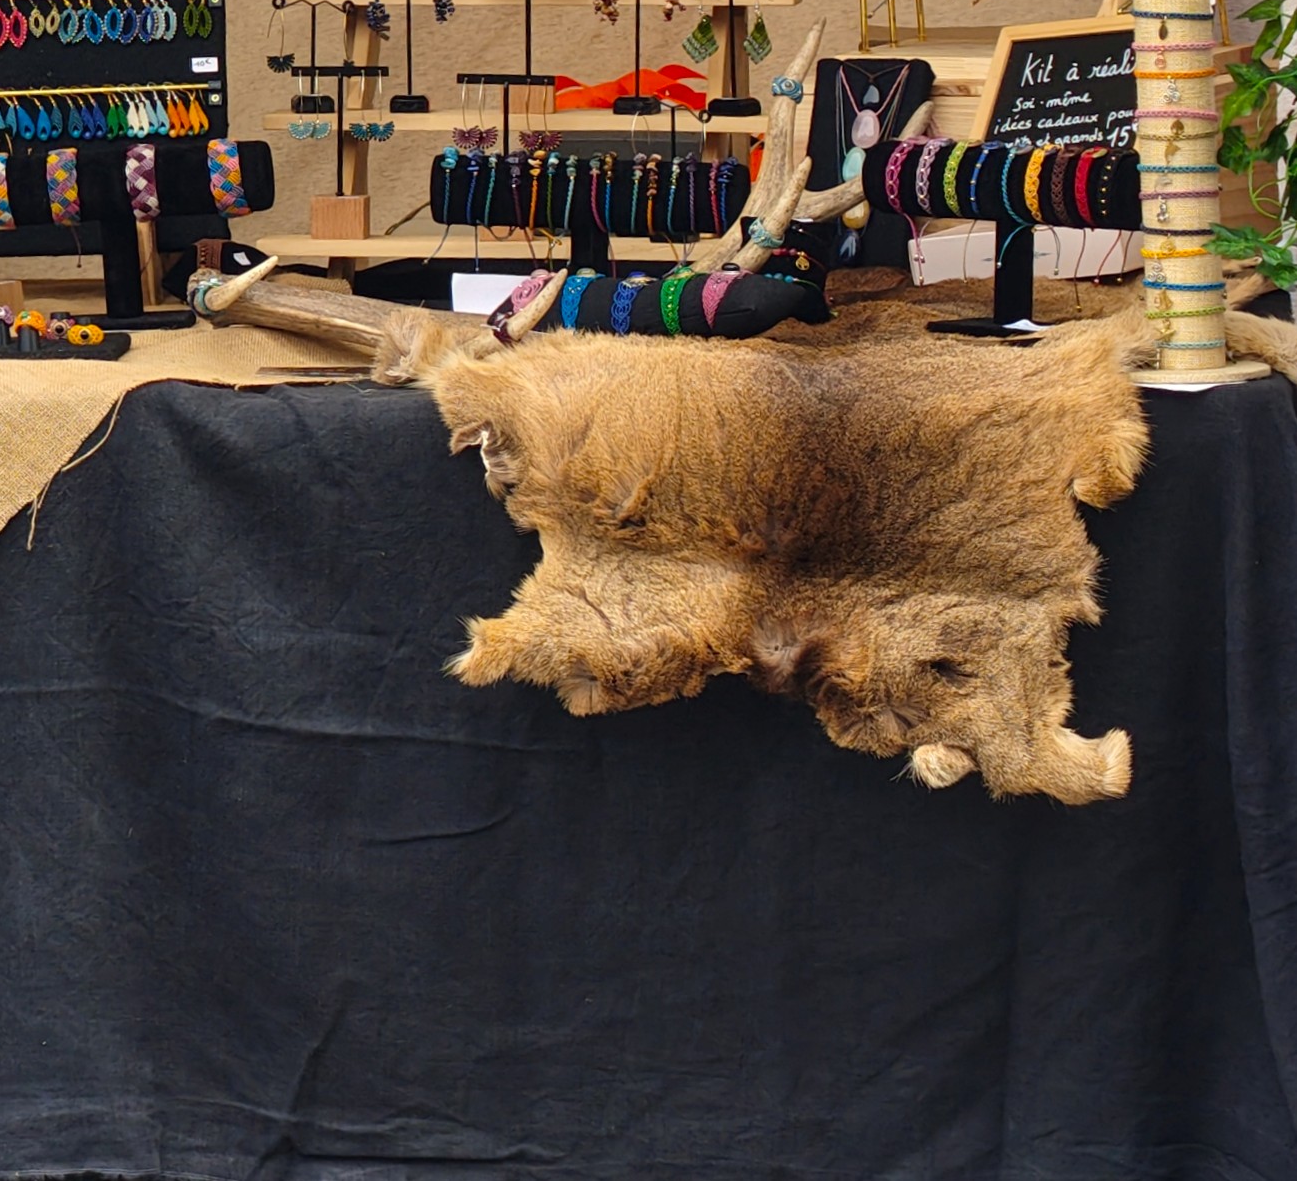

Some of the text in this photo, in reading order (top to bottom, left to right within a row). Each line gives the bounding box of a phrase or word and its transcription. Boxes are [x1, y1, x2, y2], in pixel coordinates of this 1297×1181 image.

[1020, 51, 1053, 88] Kit
[1065, 63, 1080, 81] à
[994, 114, 1032, 135] idées
[1037, 113, 1100, 130] cadeaux
